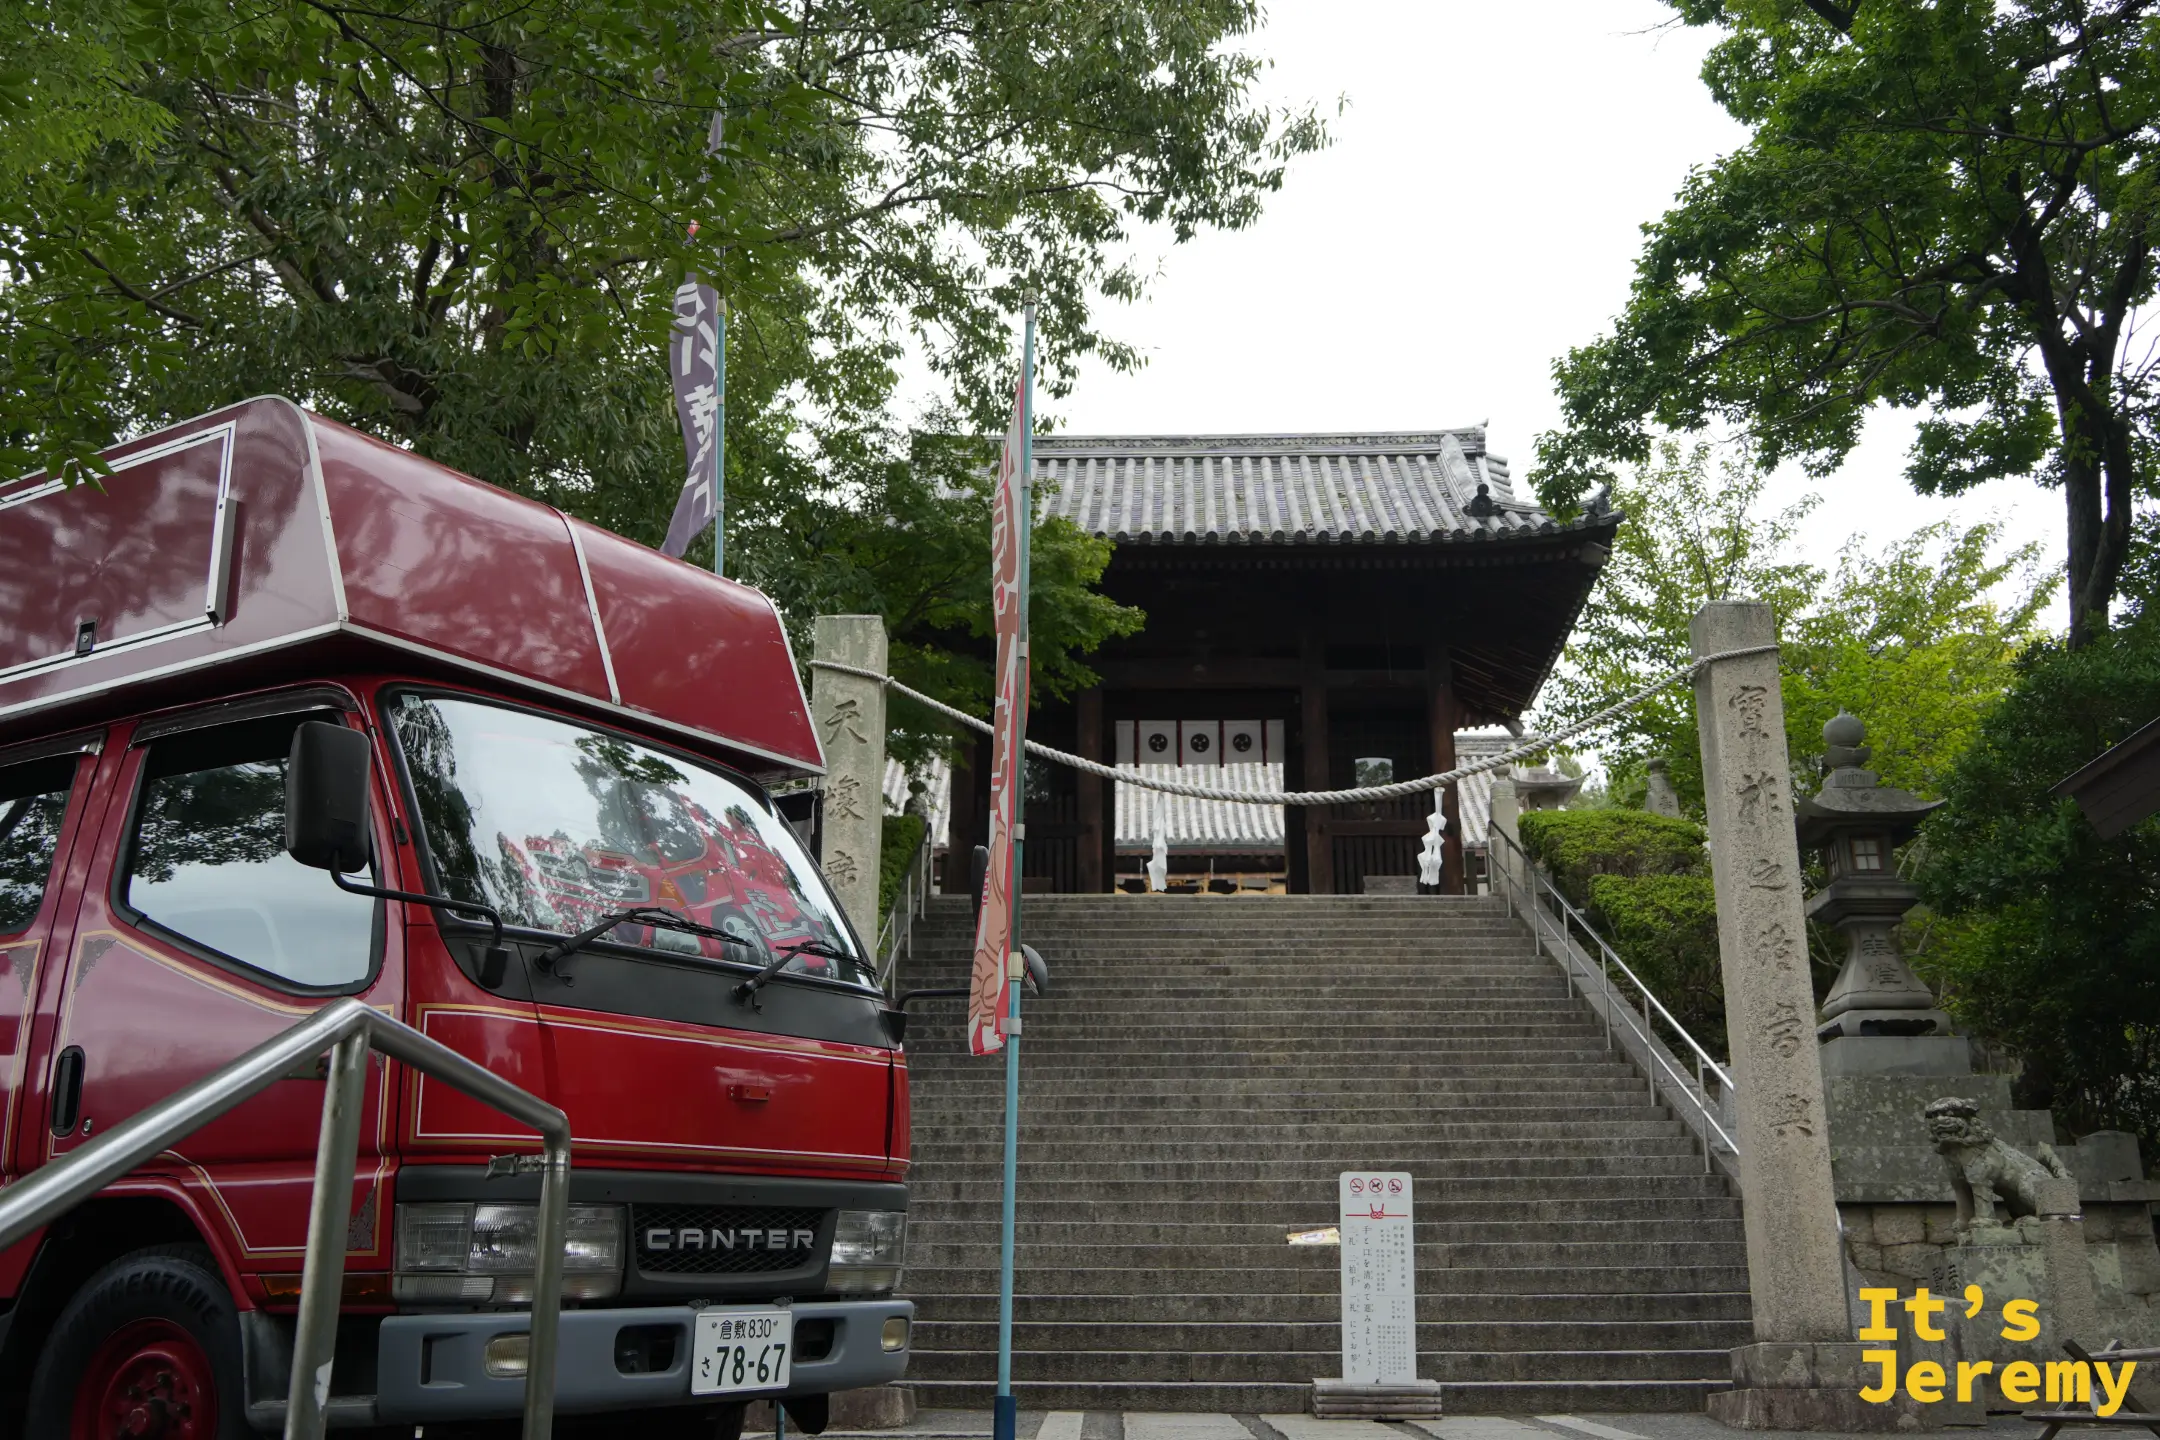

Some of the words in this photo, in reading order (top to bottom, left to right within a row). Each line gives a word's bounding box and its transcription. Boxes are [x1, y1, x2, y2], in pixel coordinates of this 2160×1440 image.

[647, 1228, 814, 1250] CANTER
[702, 1357, 710, 1377] さ
[717, 1344, 786, 1386] 78-67
